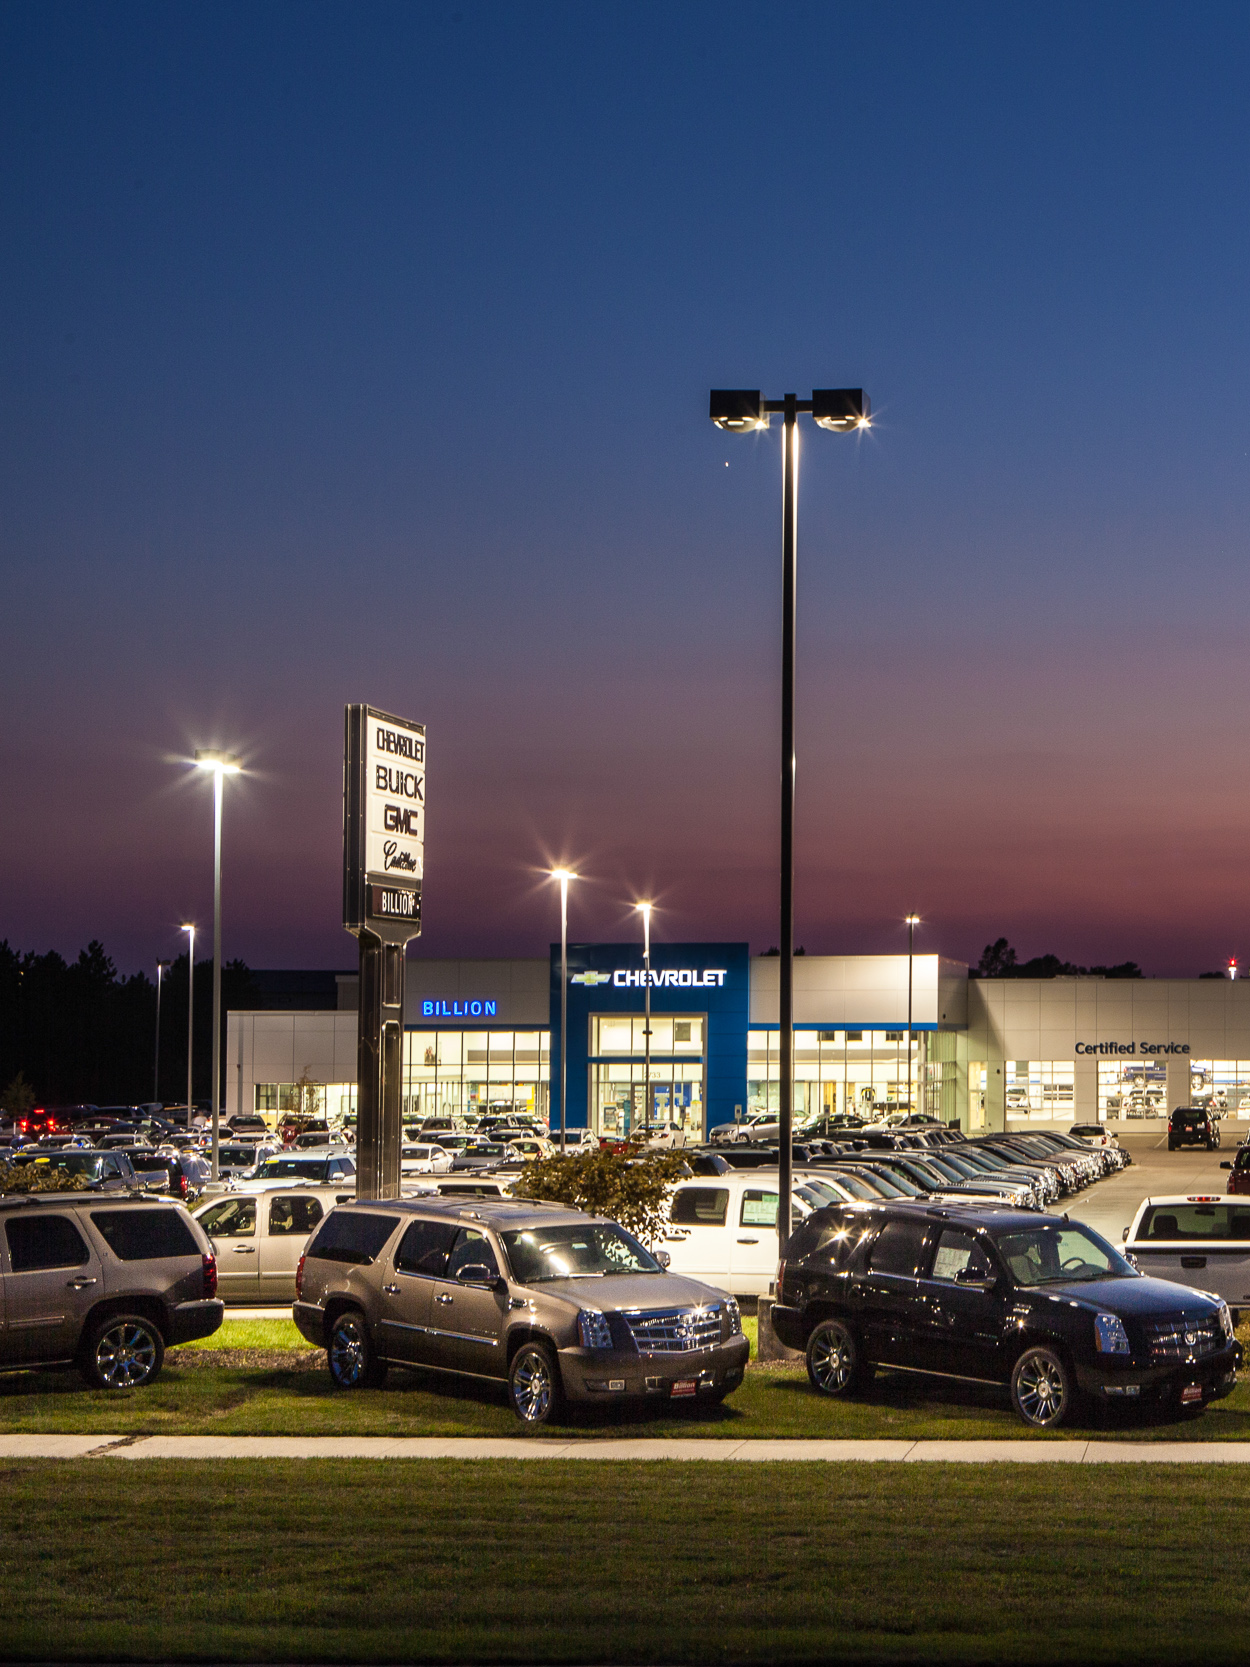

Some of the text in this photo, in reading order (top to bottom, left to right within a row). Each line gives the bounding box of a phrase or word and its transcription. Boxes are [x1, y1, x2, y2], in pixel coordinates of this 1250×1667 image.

[376, 727, 425, 763] CHEVROLET
[376, 764, 424, 801] BUICK
[384, 803, 418, 836] GMC
[382, 891, 414, 915] BILLION
[613, 969, 727, 987] CHEVROLET
[422, 1000, 497, 1017] BILLION
[1075, 1041, 1190, 1055] Certified Service
